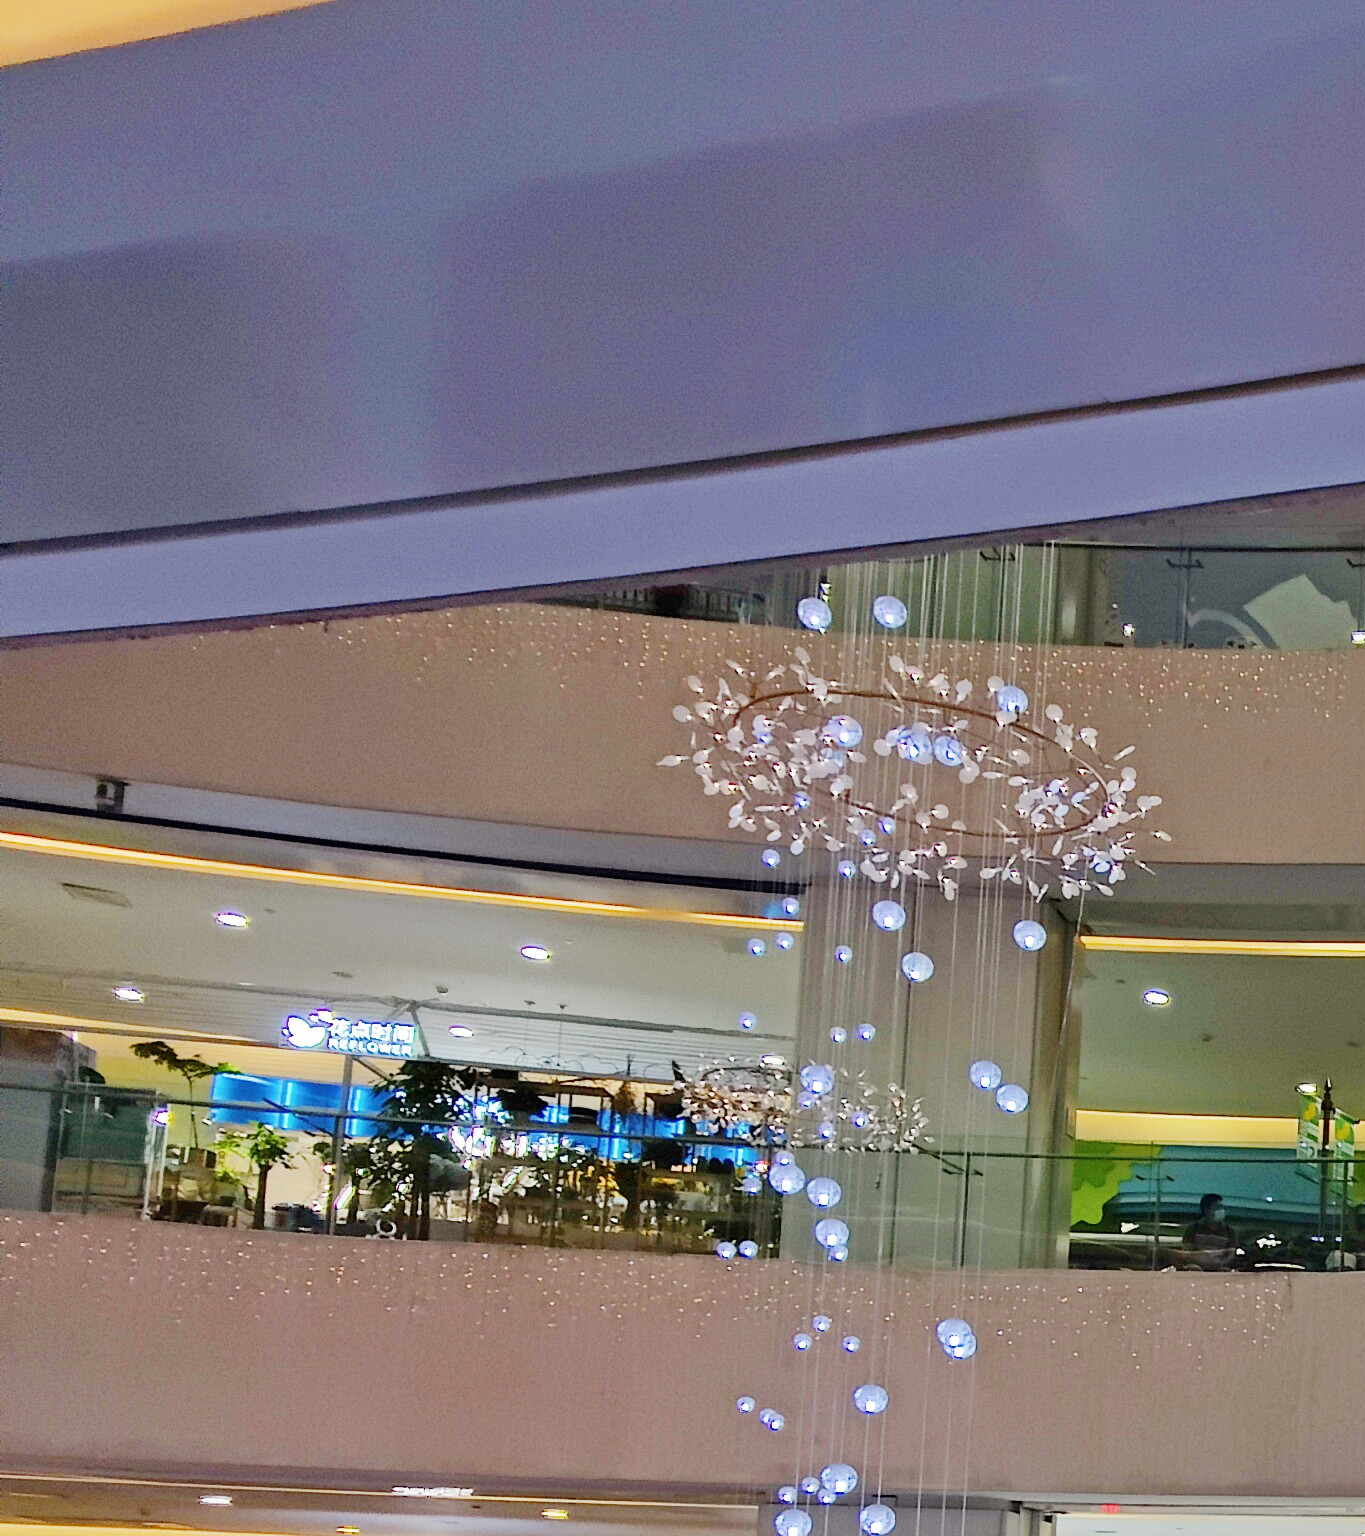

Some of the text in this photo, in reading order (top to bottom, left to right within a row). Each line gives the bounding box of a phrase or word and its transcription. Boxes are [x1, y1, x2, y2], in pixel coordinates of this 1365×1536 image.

[329, 1017, 414, 1044] 花点时间
[328, 1038, 414, 1057] REFLOWER
